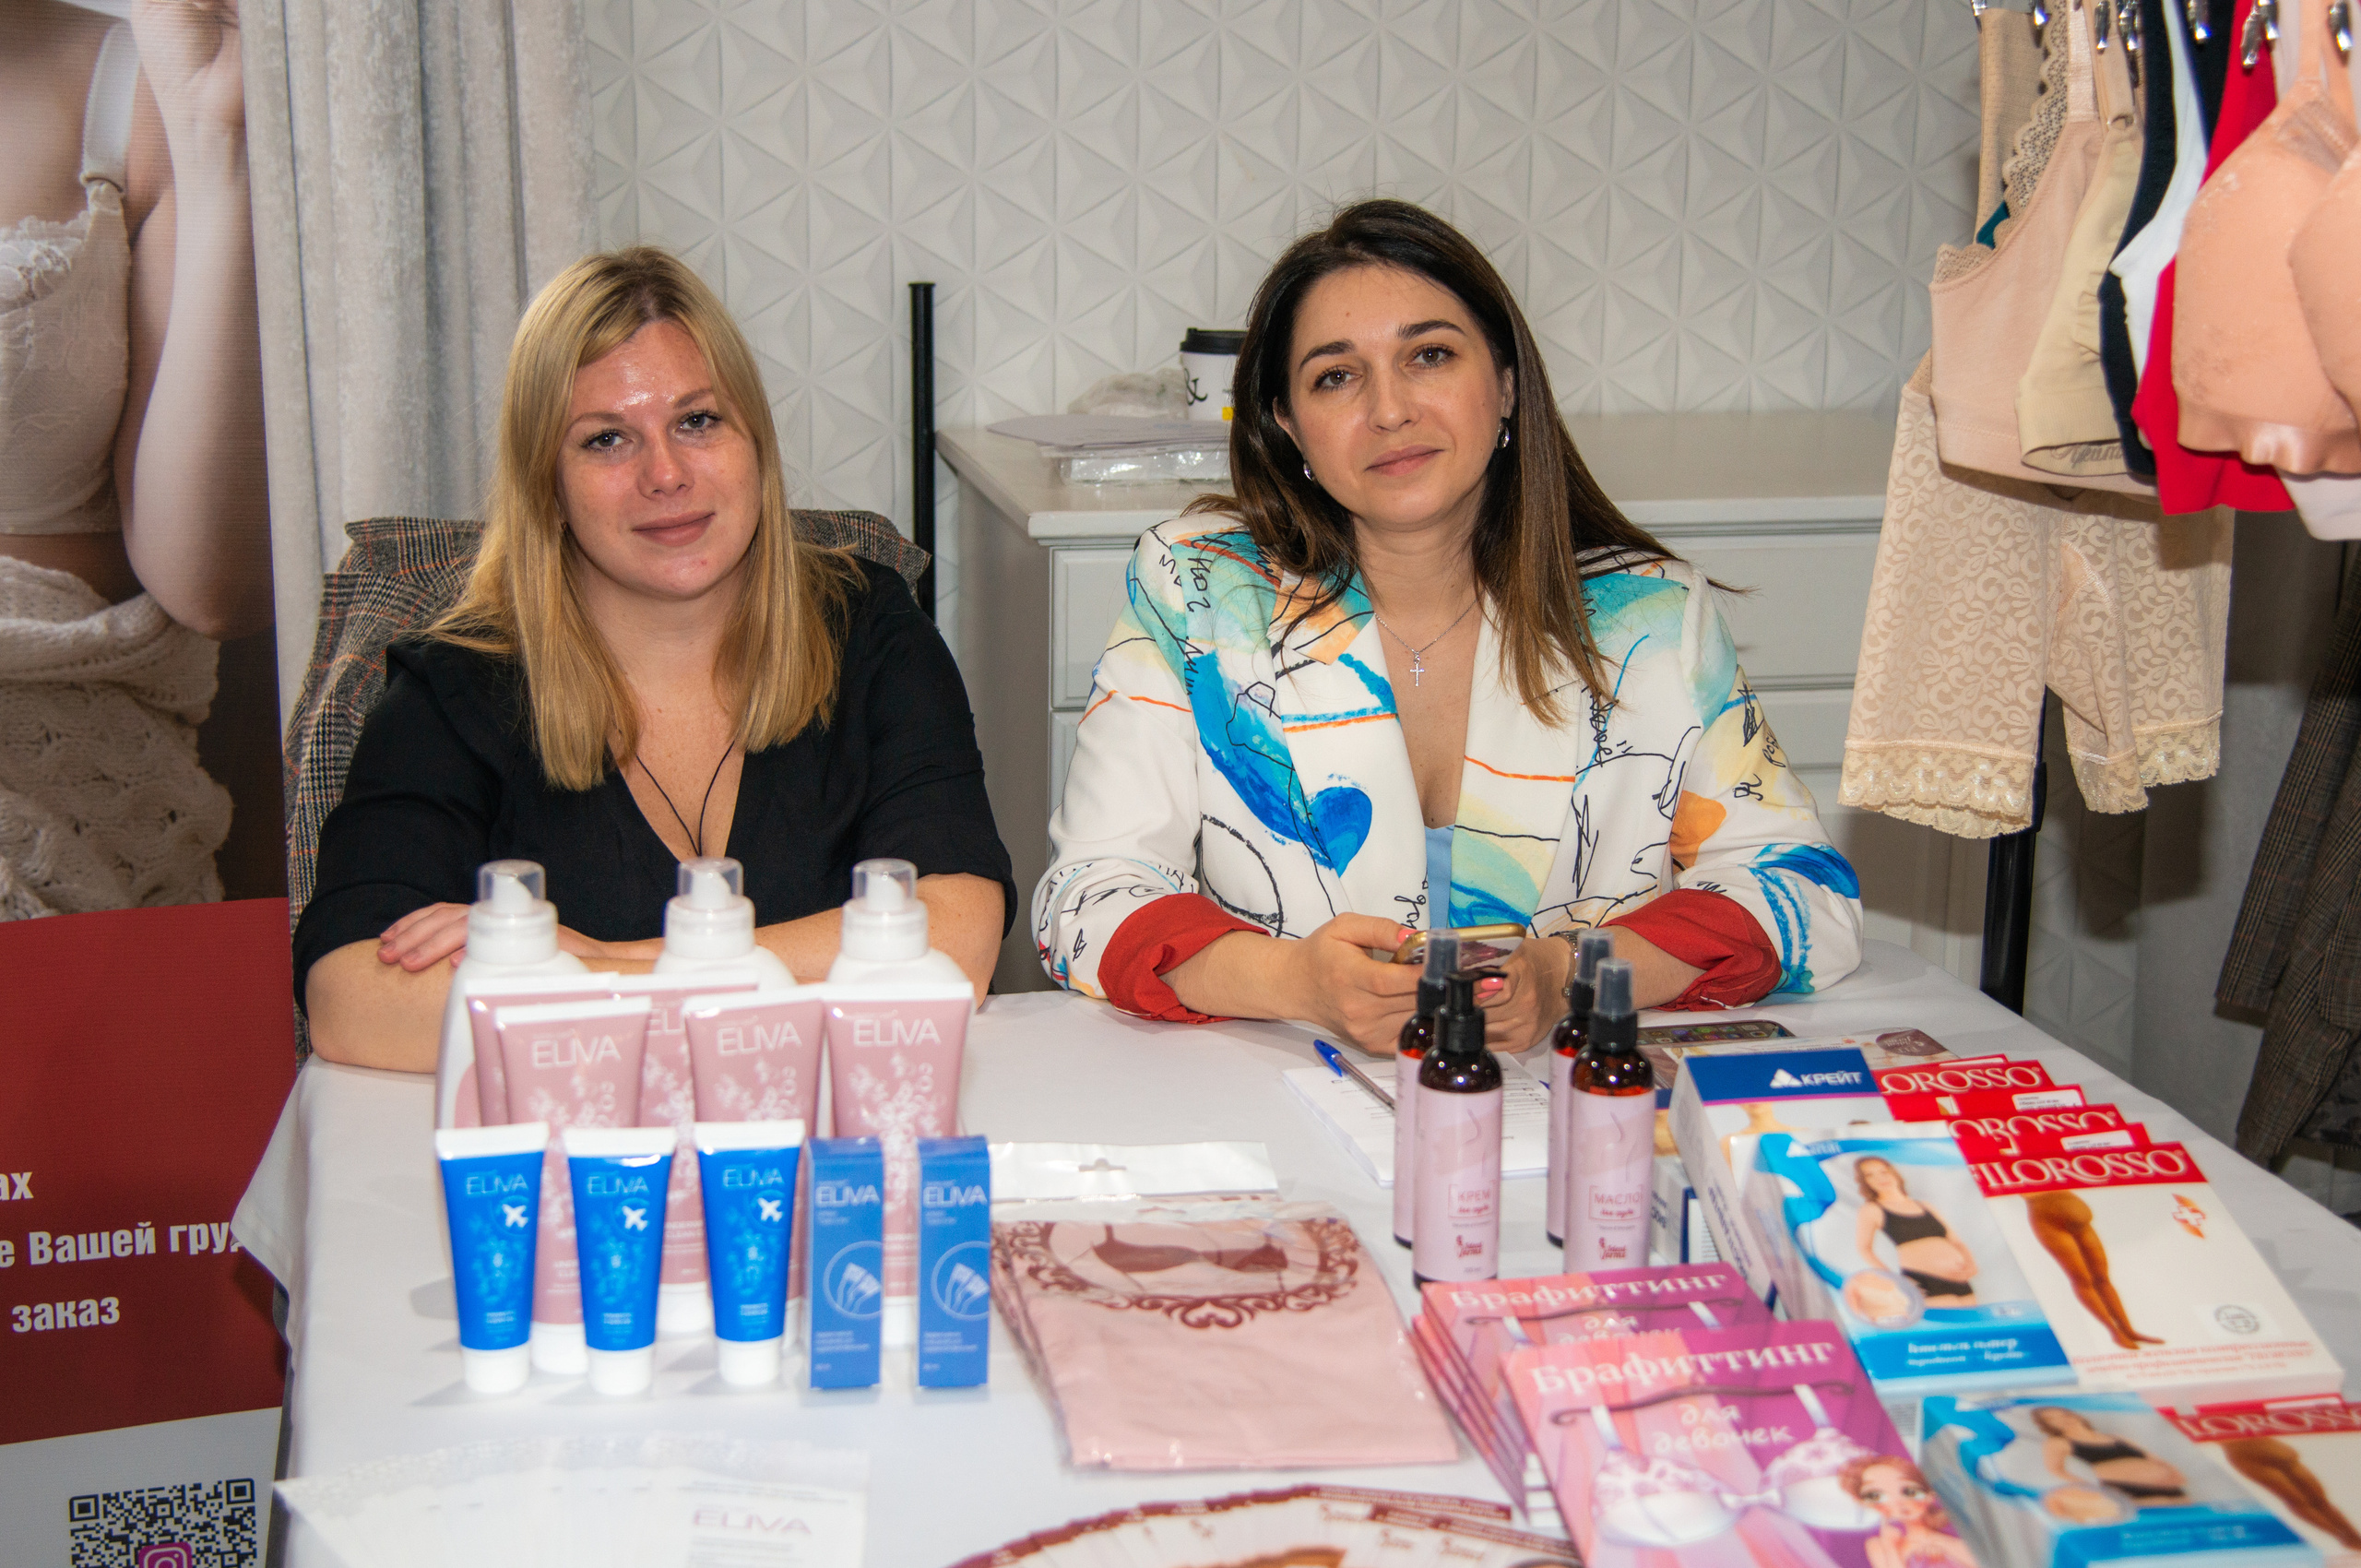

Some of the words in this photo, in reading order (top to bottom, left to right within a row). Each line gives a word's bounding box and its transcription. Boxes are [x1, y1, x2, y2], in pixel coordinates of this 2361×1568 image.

[716, 1020, 803, 1057] ELIVA
[852, 1017, 942, 1048] ELIVA
[531, 1034, 623, 1070] ELIVA
[1800, 1070, 1863, 1087] КРЕЙТ
[466, 1172, 529, 1195] ELIVA
[587, 1174, 649, 1196] ELIVA
[722, 1167, 785, 1190] ELIVA
[815, 1184, 881, 1208] ELIVA
[922, 1184, 988, 1208] ELIVA
[1595, 1192, 1641, 1206] МАСЛО
[29, 1221, 157, 1265] Вашей
[1451, 1273, 1728, 1311] Брафиттинг
[12, 1296, 121, 1334] заказ
[1529, 1341, 1835, 1396] Брафиттинг
[1679, 1402, 1746, 1426] для
[1652, 1425, 1796, 1455] девочек
[694, 1507, 813, 1536] ELIVA
